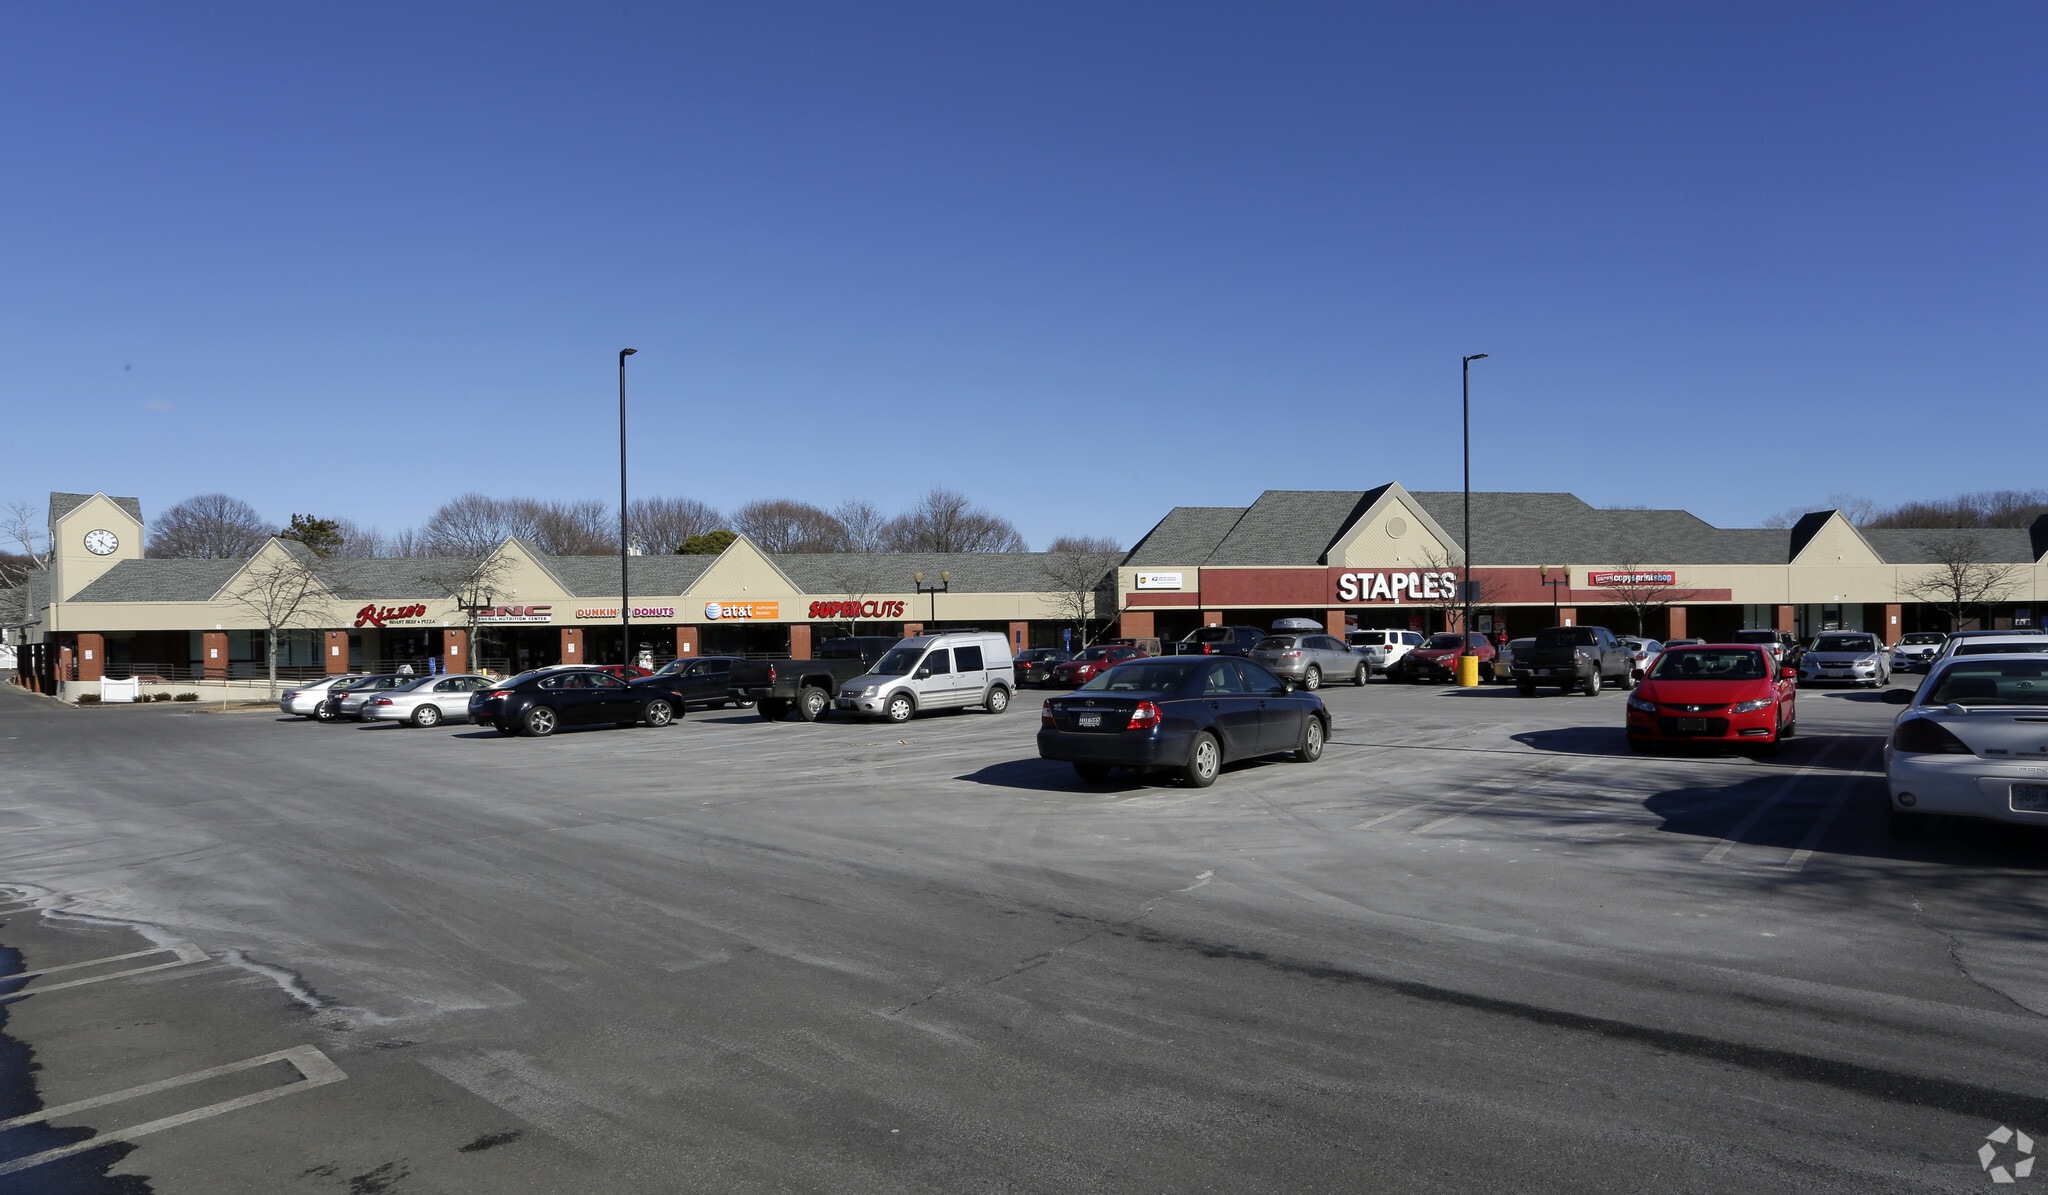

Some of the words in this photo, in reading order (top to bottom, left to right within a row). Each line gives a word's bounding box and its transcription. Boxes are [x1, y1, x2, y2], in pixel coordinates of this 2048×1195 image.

[1339, 572, 1457, 600] STAPLES
[354, 603, 427, 628] Rizzo's
[576, 608, 620, 617] DUNKIN'
[633, 607, 675, 616] DONUTS
[722, 604, 753, 617] at&t
[808, 600, 905, 618] SUPERCUTS
